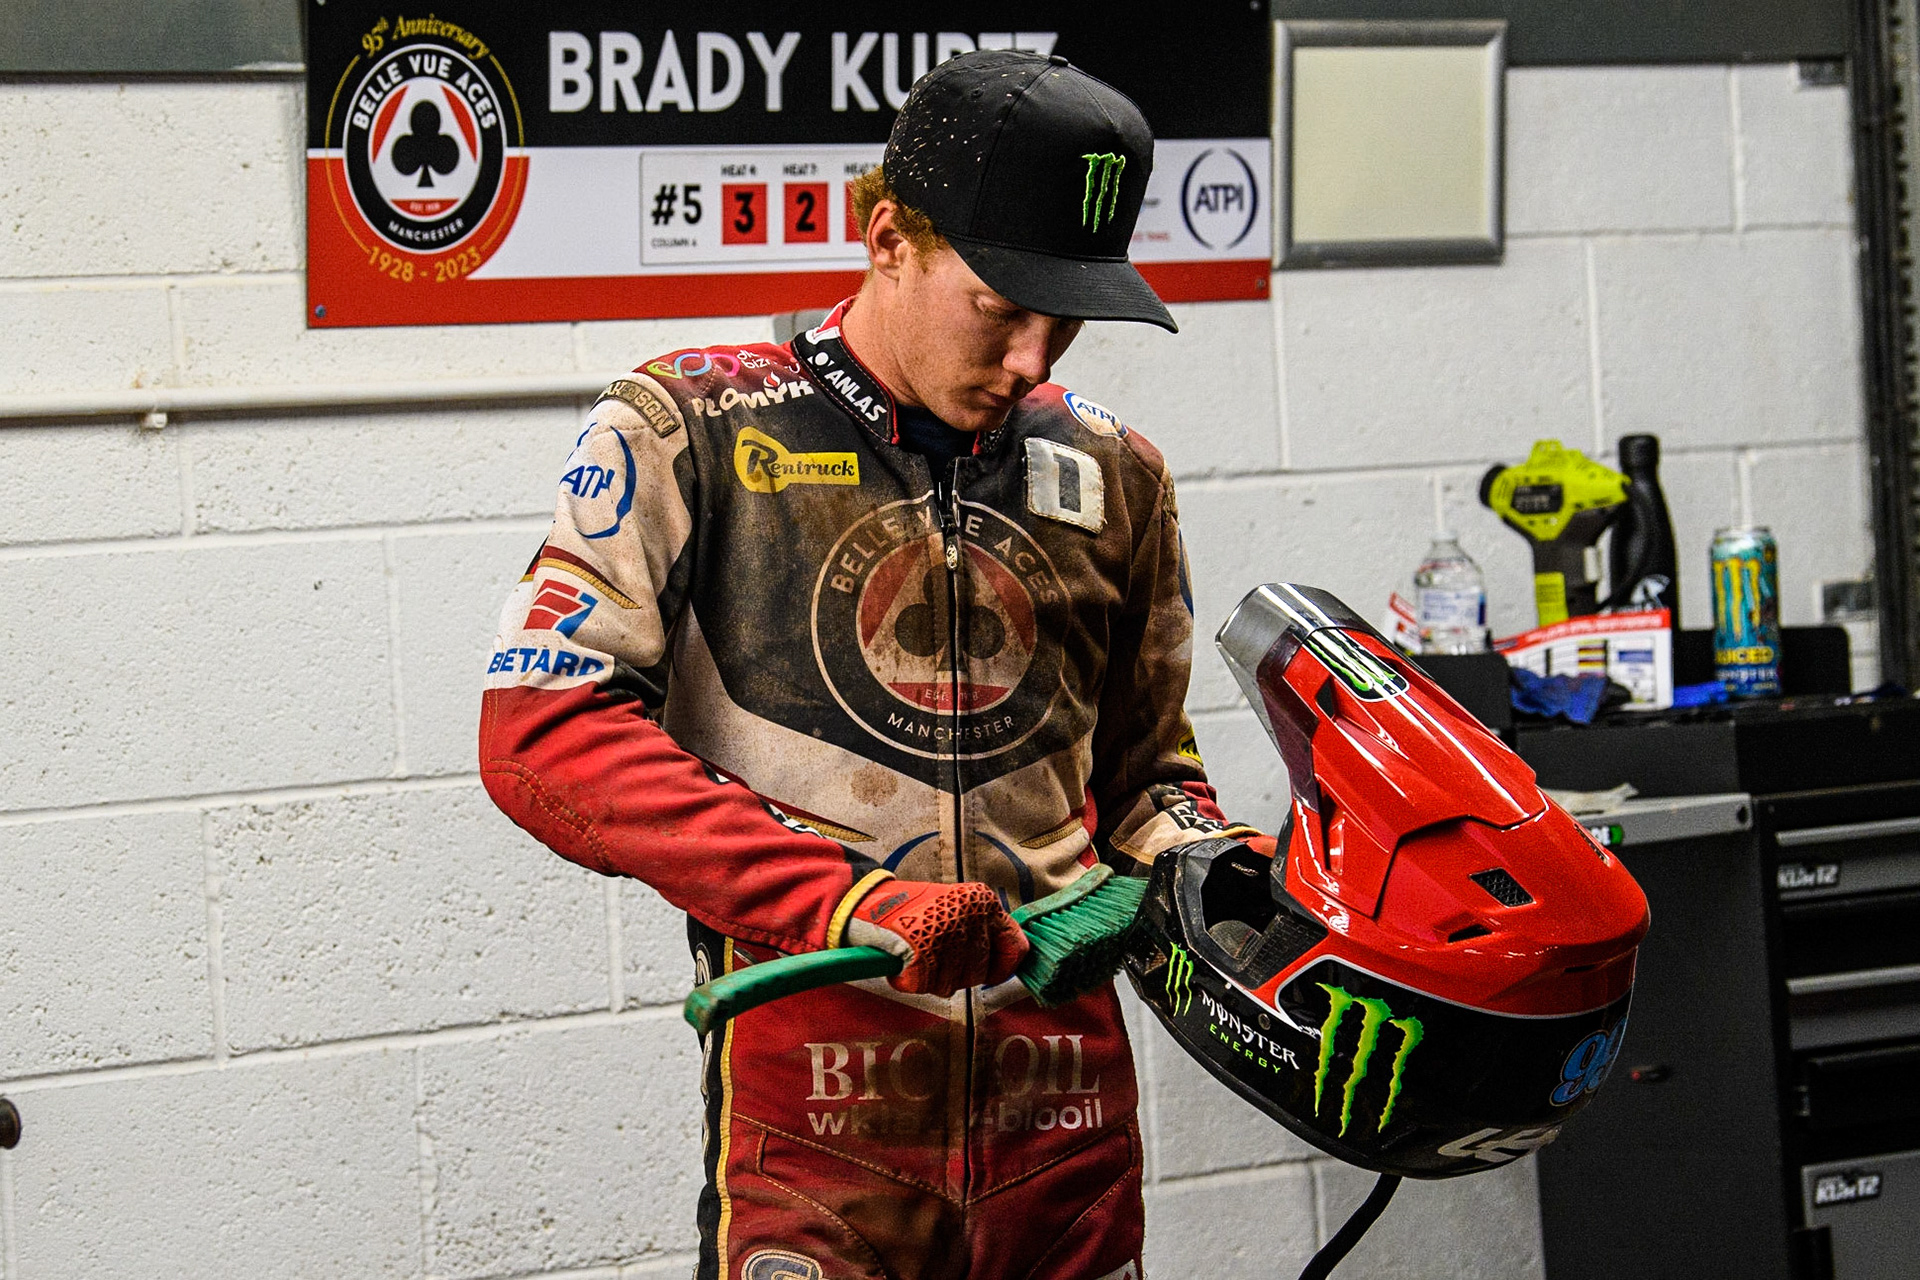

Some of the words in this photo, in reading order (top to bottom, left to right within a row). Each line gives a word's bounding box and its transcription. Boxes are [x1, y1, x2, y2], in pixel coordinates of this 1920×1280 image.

[391, 12, 490, 60] Anniversary
[548, 28, 801, 113] BRADY
[352, 62, 403, 130] BELLE
[408, 54, 453, 79] VUE
[455, 71, 498, 129] ACES
[720, 164, 747, 176] HEAT
[783, 163, 808, 176] HEAT
[651, 183, 702, 226] #5
[734, 191, 754, 233] 3
[796, 191, 815, 232] 2
[1193, 184, 1245, 213] ATPI
[387, 218, 465, 242] MANCHESTER
[369, 246, 414, 283] 1928
[434, 246, 481, 283] 2023
[824, 369, 888, 421] ANLAS
[1077, 402, 1116, 427] ATPI
[741, 439, 855, 479] Rentruck
[831, 516, 903, 594] BELLE
[994, 536, 1059, 604] ACES
[486, 648, 605, 677] BETARD
[886, 711, 1014, 741] MANCHESTER
[1201, 989, 1300, 1070] MONSTER
[1209, 1023, 1281, 1074] ENERGY
